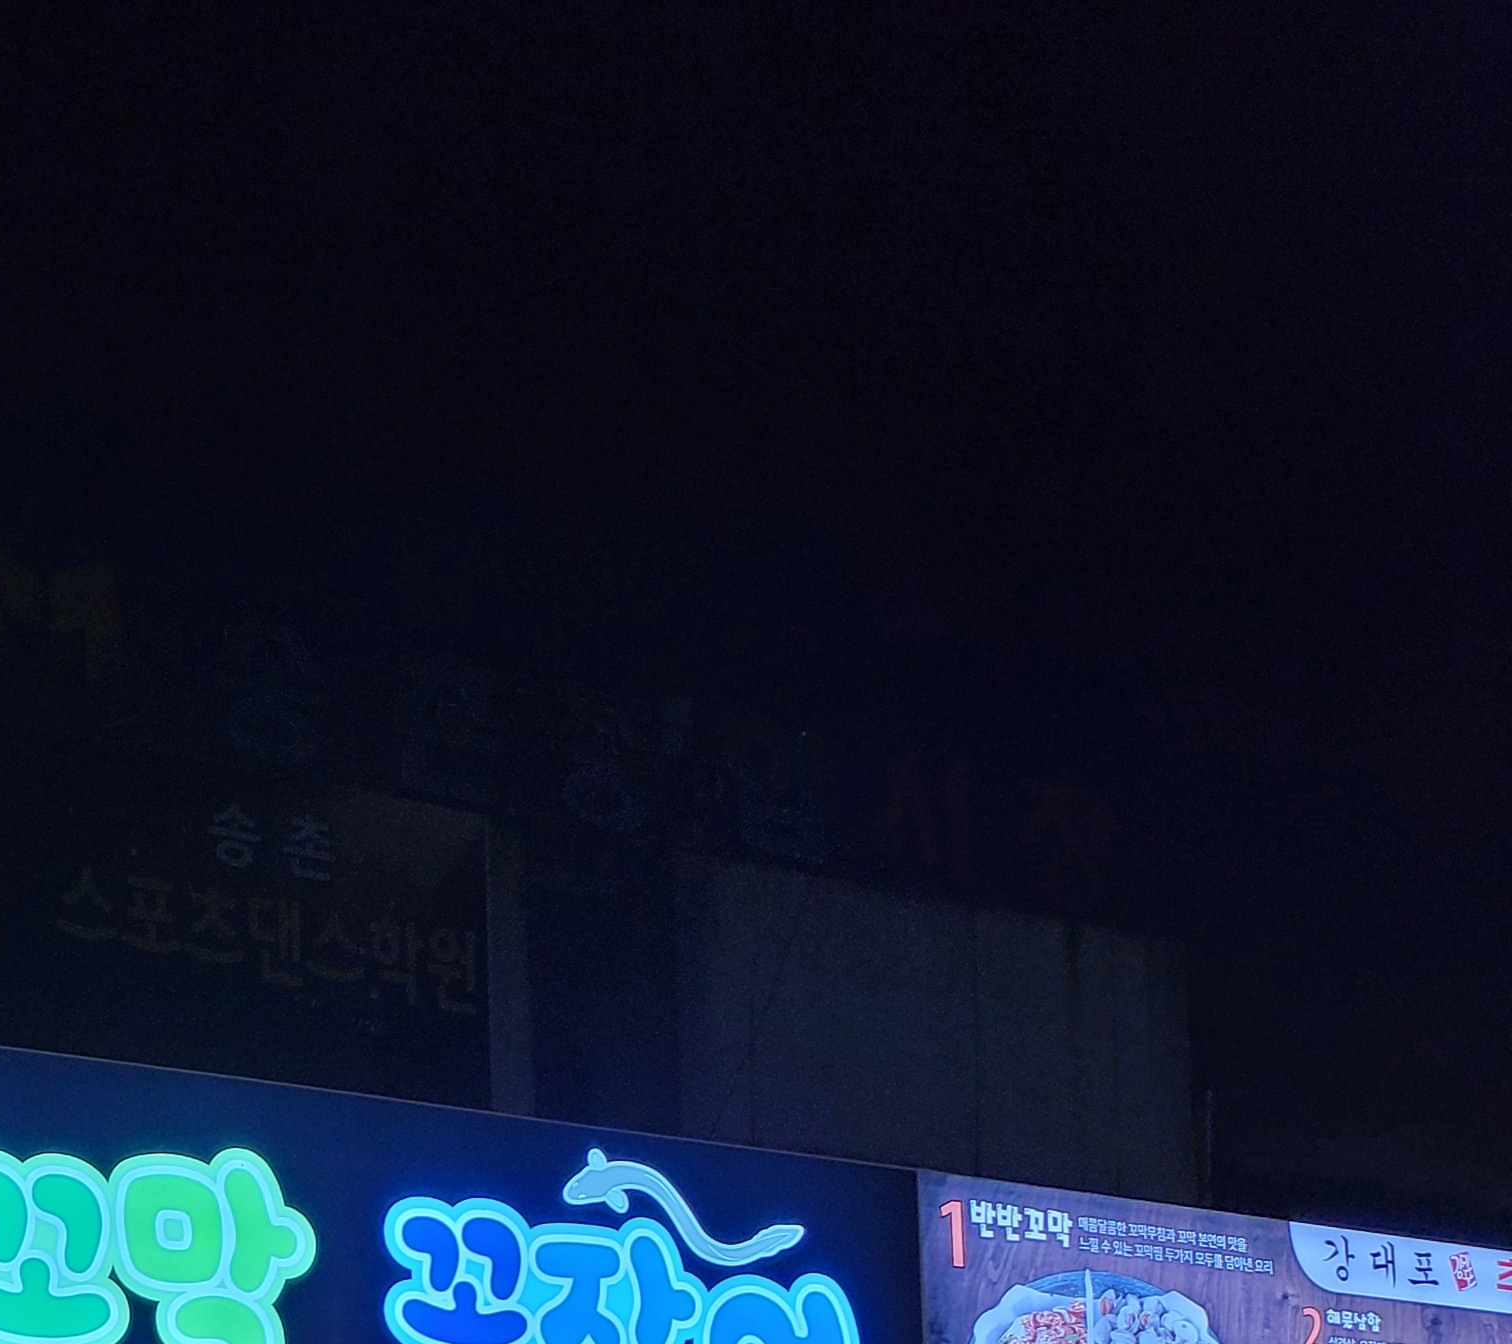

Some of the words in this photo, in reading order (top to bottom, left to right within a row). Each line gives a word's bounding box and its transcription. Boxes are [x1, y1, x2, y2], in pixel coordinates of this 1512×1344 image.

[940, 1200, 964, 1268] 1
[969, 1199, 1074, 1248] 반반꼬막
[1101, 1240, 1112, 1254] 수
[1323, 1235, 1439, 1289] 강대포
